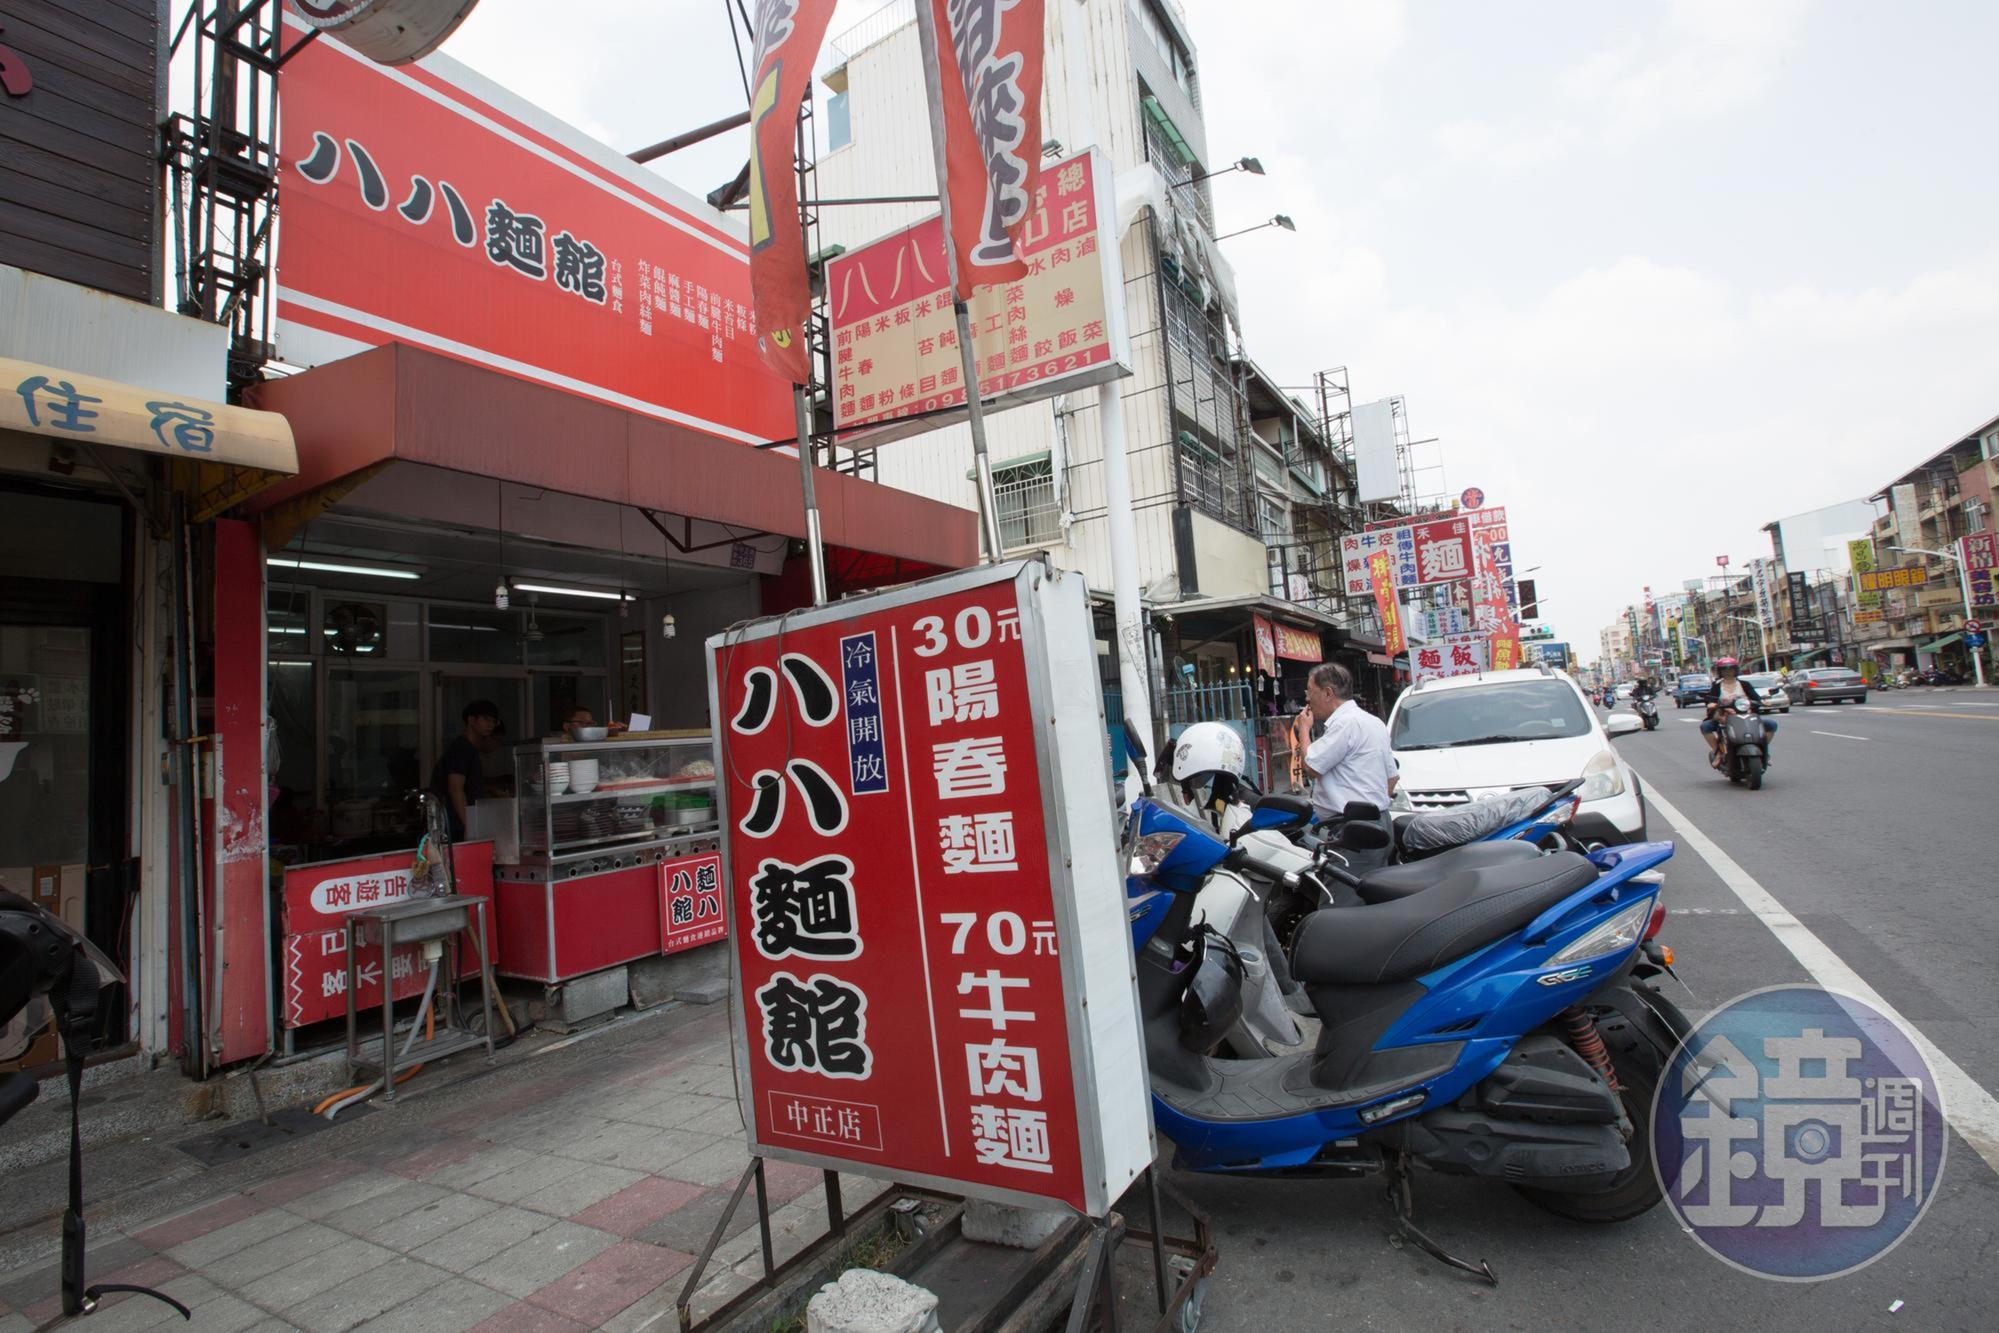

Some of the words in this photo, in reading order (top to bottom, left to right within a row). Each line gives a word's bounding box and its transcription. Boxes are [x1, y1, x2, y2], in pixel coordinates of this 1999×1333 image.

[296, 130, 608, 305] 八八麵館
[1057, 162, 1088, 235] 總店
[684, 281, 696, 324] 手工麵
[836, 330, 856, 419] 前腱牛肉麵
[16, 375, 216, 452] 住宿
[1419, 538, 1468, 581] 麵
[912, 605, 1022, 658] 30元
[845, 640, 885, 783] 冷氣開放
[925, 659, 1019, 875] 陽春麵
[731, 651, 874, 1081] 八八麵館
[941, 911, 1058, 957] 70元
[957, 969, 1054, 1175] 牛肉麵
[786, 1100, 861, 1141] 中正店
